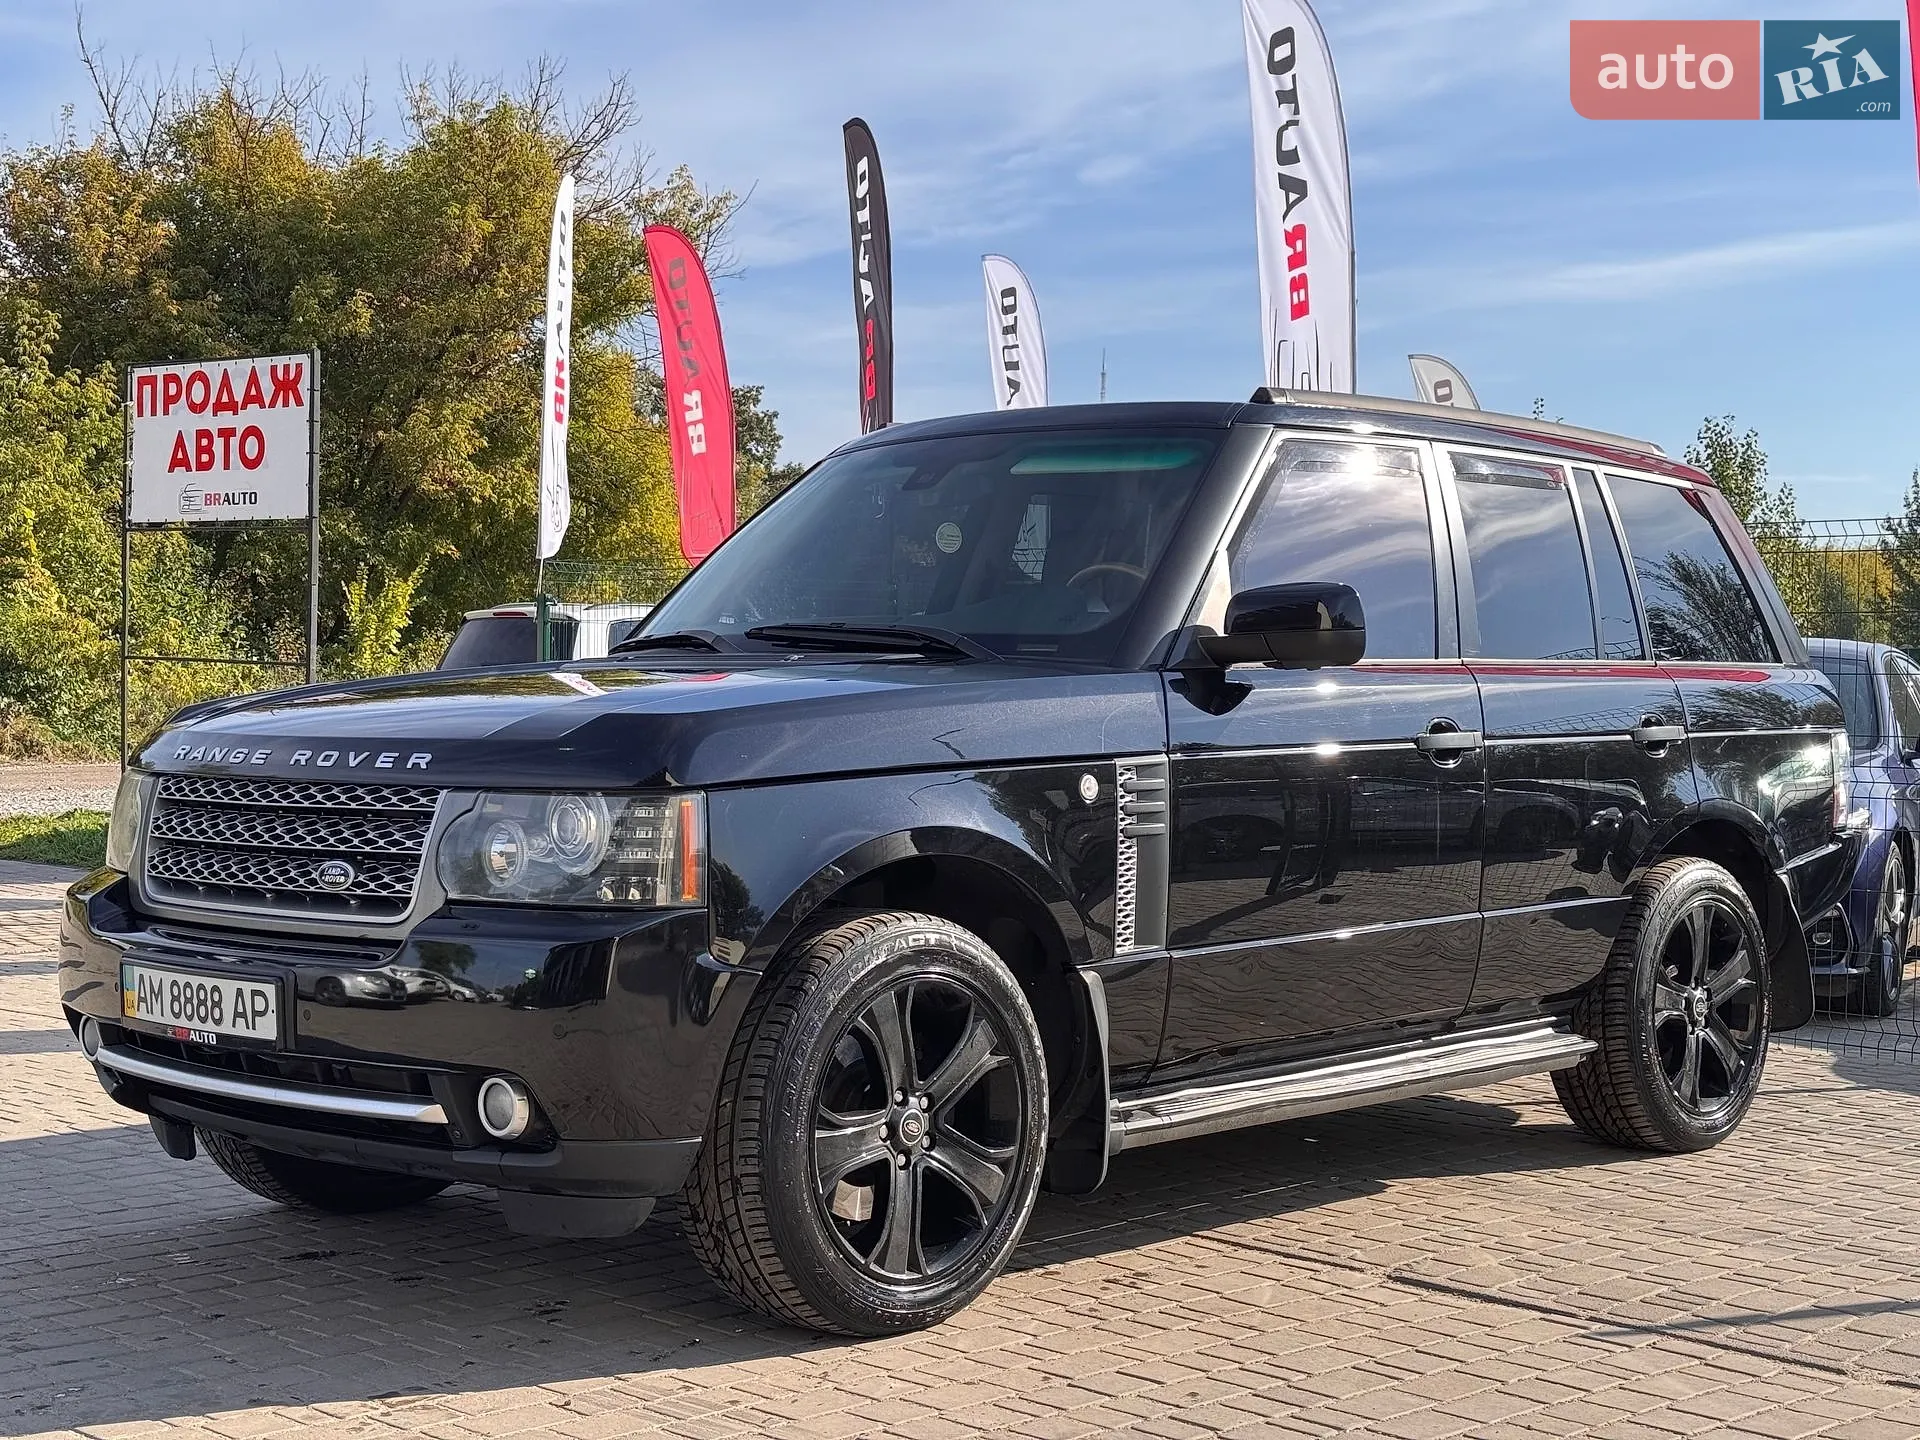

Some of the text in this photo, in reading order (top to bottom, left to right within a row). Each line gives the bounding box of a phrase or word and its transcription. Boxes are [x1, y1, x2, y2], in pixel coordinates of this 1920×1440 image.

[136, 363, 304, 417] ПРОДАЖ
[168, 425, 265, 473] АВТО
[204, 492, 257, 506] BRAUTO
[173, 744, 432, 769] RANGE ROVER
[137, 974, 269, 1030] AM 8888 AP
